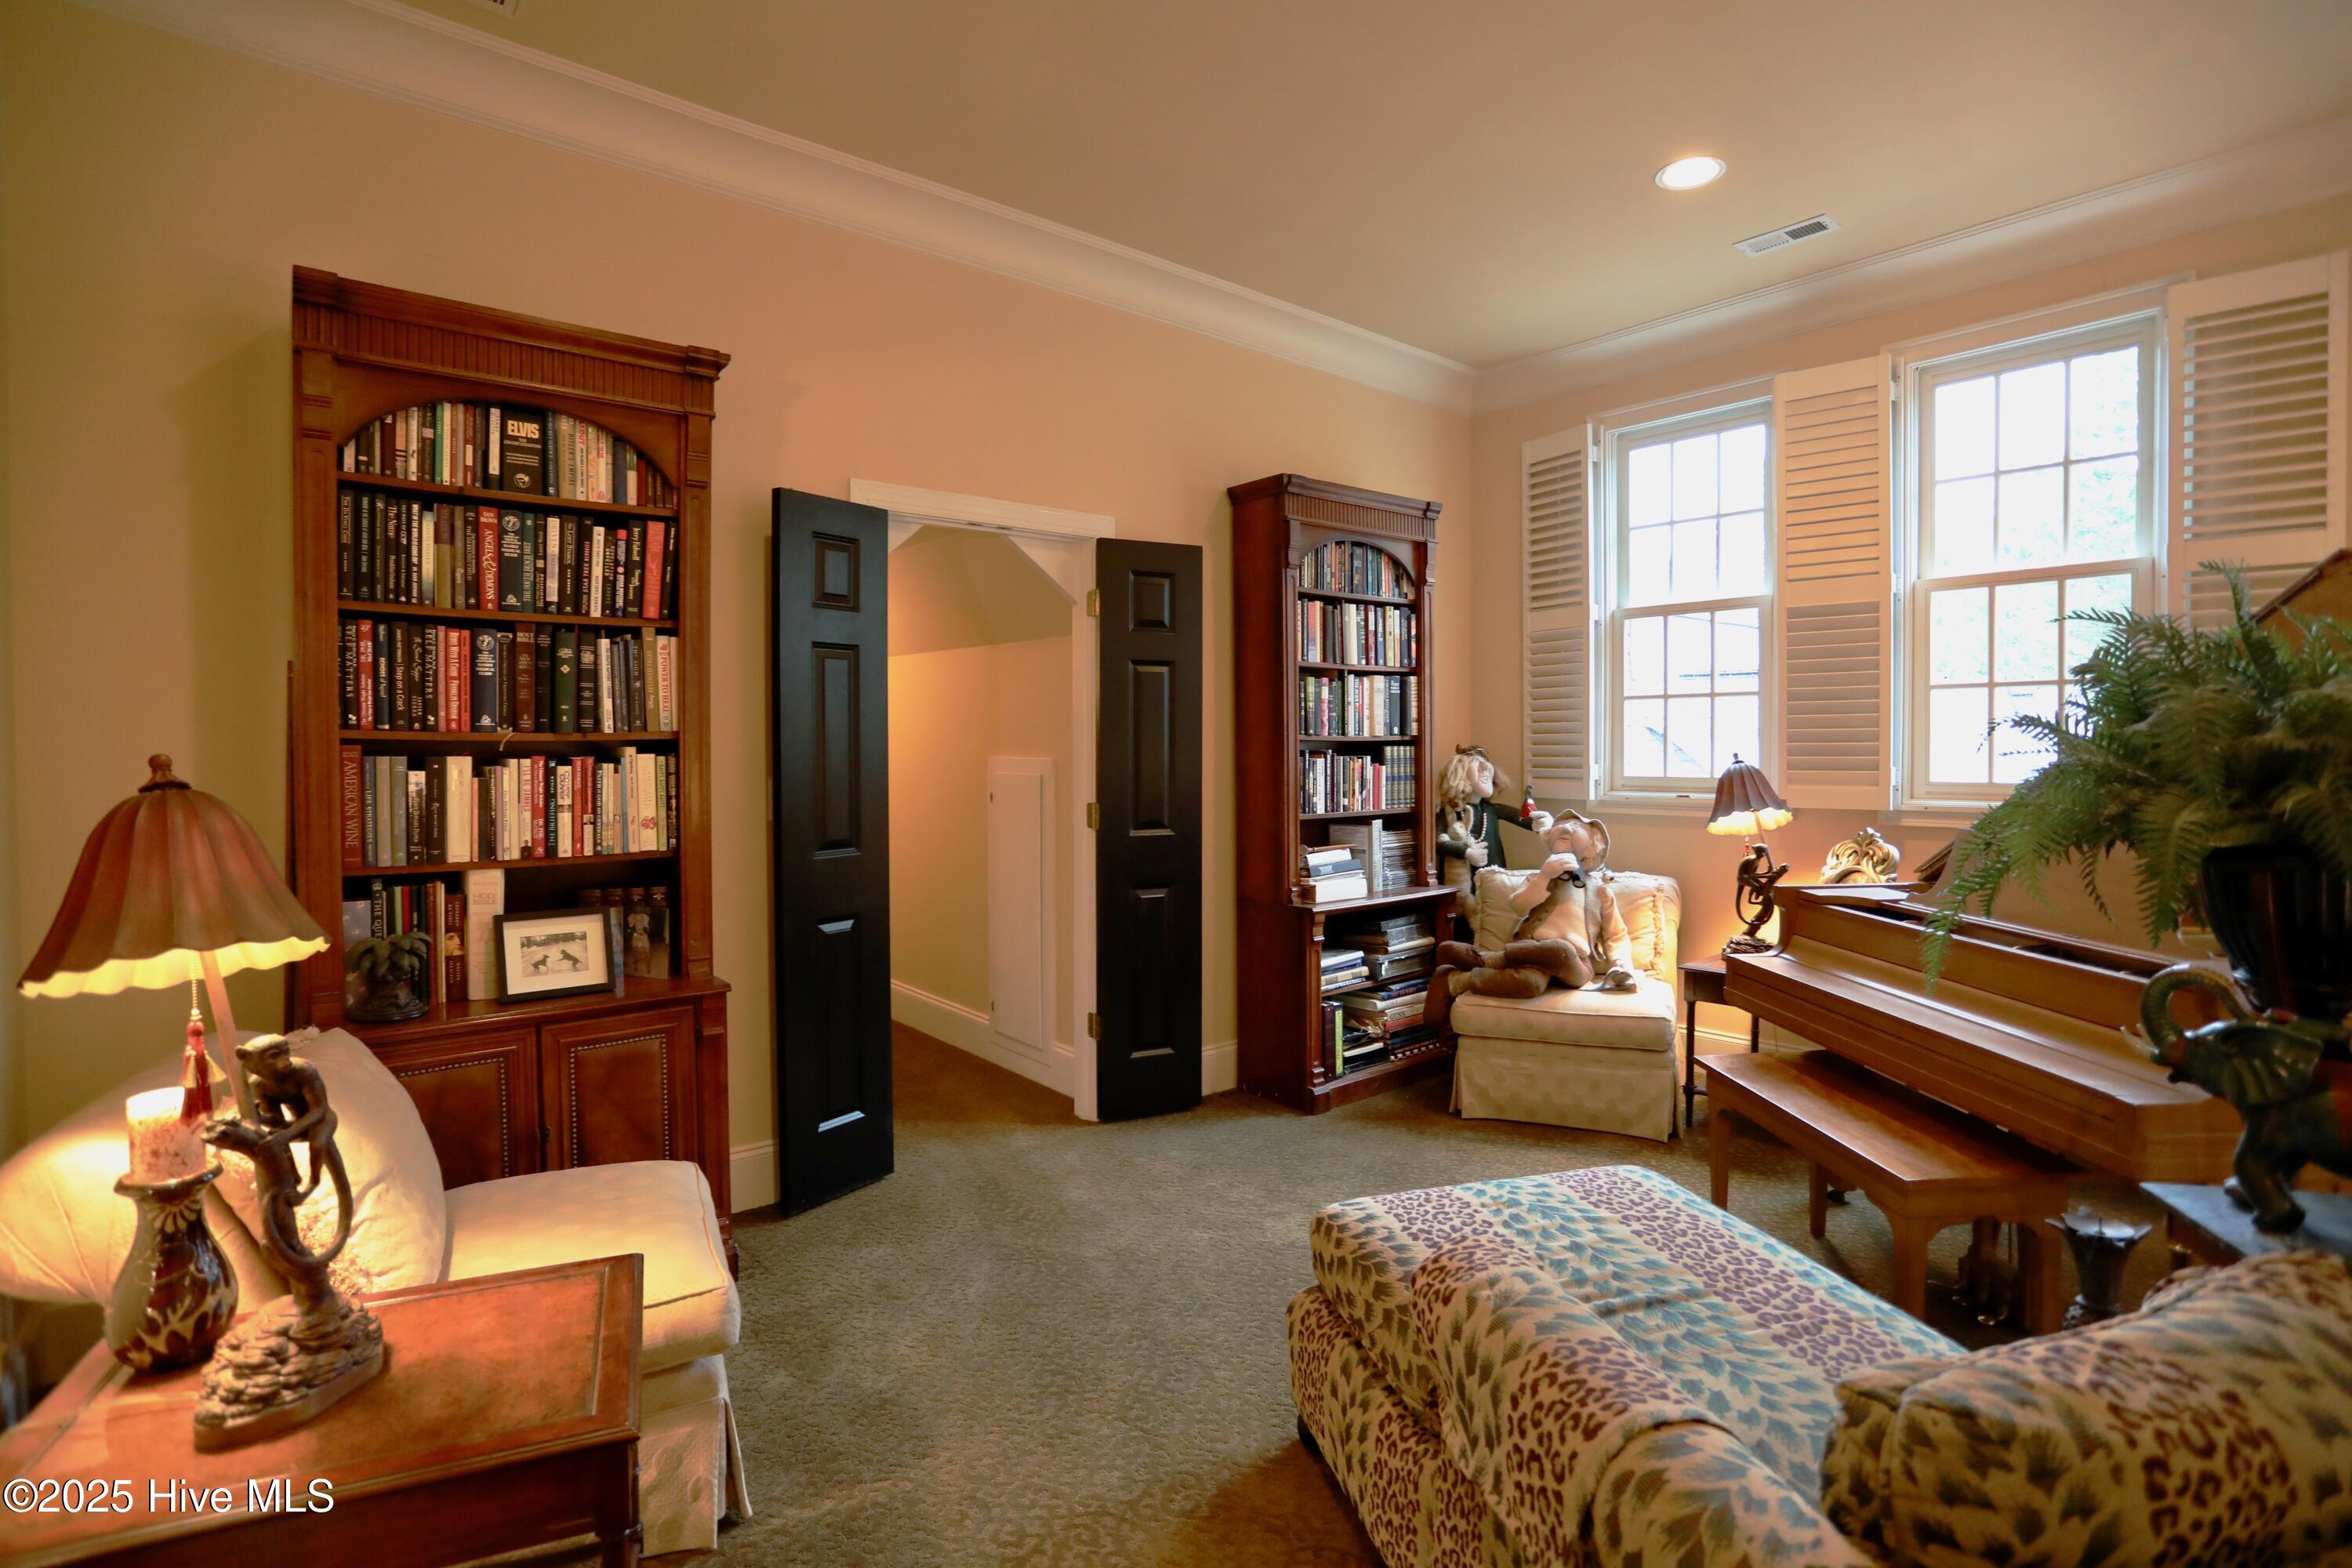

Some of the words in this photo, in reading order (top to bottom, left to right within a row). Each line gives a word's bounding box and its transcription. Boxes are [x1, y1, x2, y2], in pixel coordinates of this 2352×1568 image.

[506, 419, 540, 439] ELVIS
[631, 528, 641, 541] Jerry
[485, 529, 494, 557] ANGELS
[482, 556, 496, 571] &
[485, 570, 495, 600] DEMONS
[395, 666, 405, 680] Step
[662, 684, 669, 693] TO
[397, 695, 405, 710] Crack
[344, 761, 358, 815] AMERICAN
[345, 818, 358, 848] WINE
[1389, 1011, 1406, 1020] GUNS
